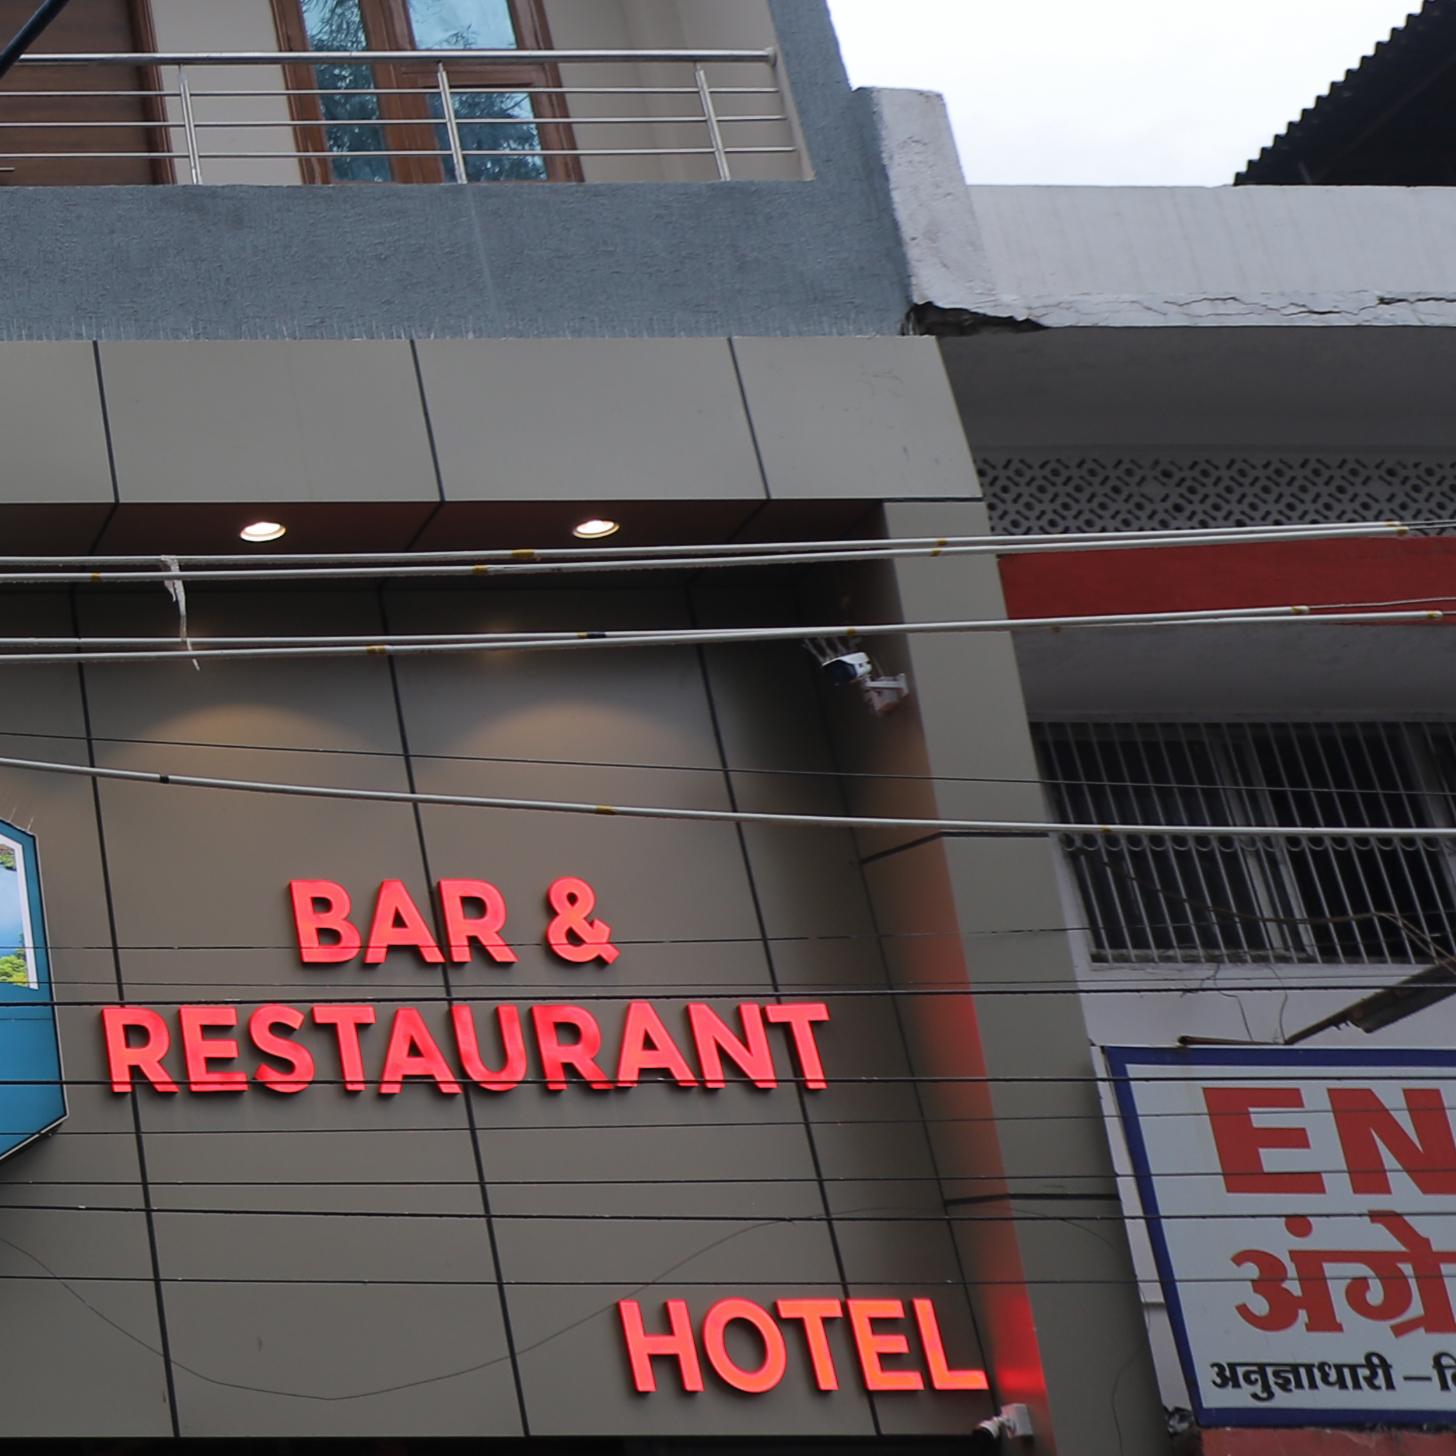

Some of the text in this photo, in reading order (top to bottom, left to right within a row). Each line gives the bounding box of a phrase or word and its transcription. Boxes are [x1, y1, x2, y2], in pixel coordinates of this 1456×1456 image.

[288, 875, 622, 966] BAR &
[100, 1000, 832, 1096] RESTAURANT
[617, 1297, 990, 1394] HOTEL
[1209, 1351, 1396, 1402] अनुज्ञाधारी
